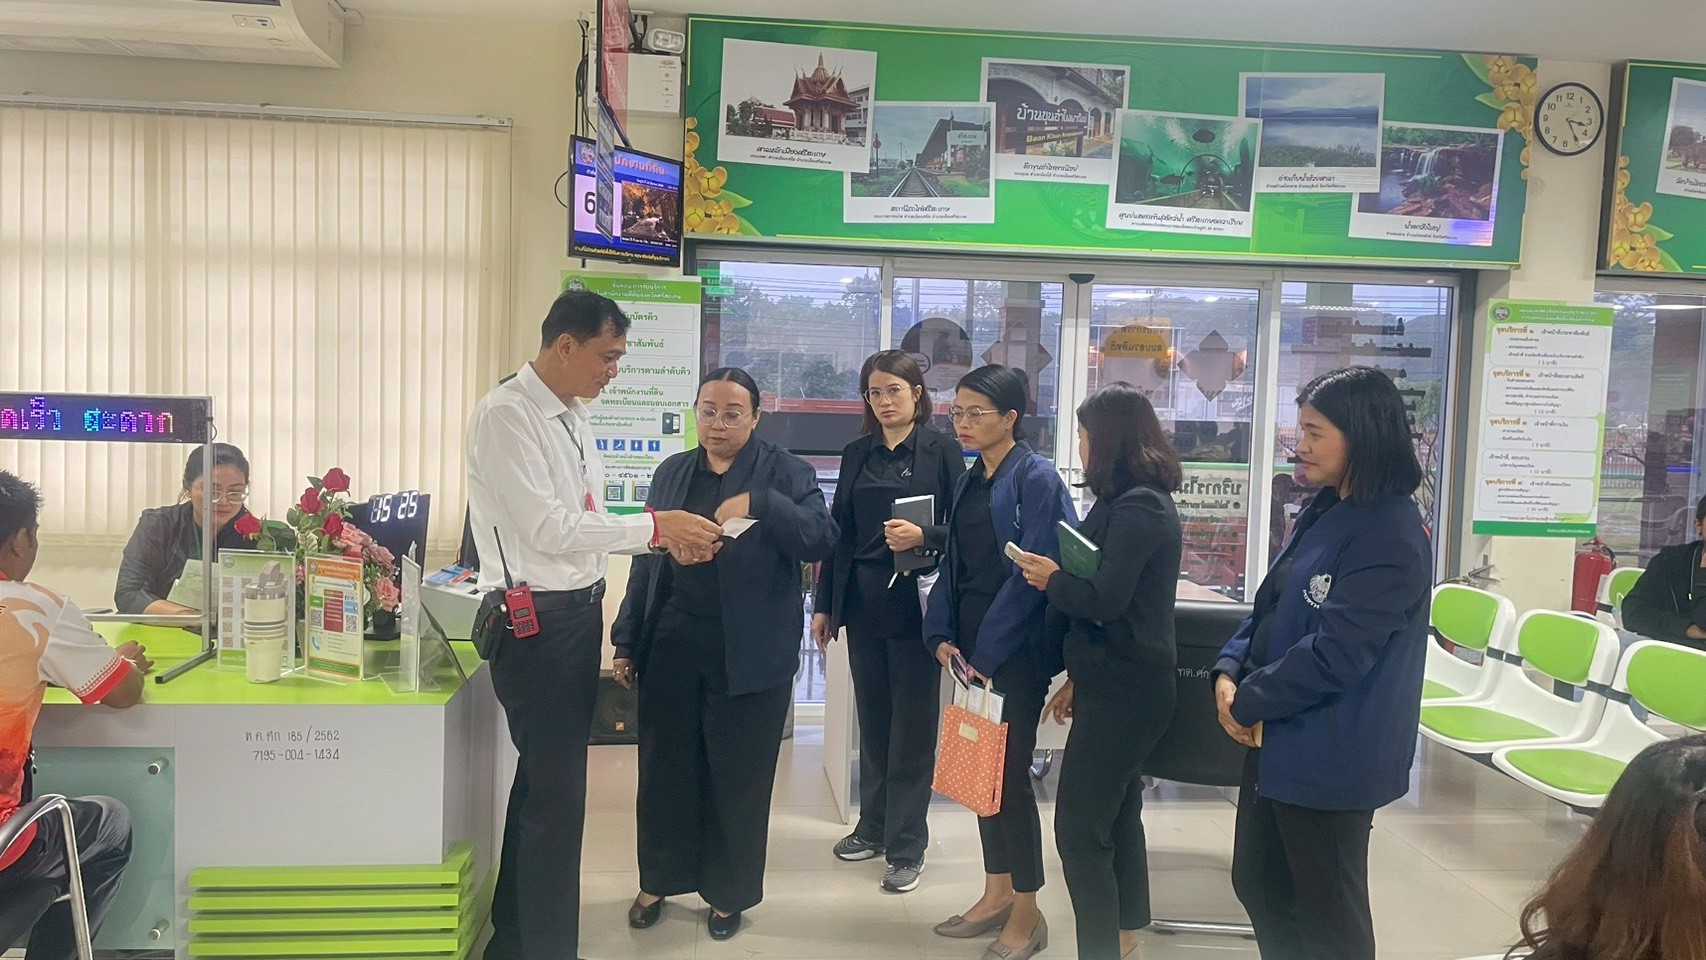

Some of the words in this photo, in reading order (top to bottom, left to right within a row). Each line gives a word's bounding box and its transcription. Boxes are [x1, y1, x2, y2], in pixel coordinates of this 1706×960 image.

[1566, 92, 1575, 100] 12
[1543, 114, 1548, 122] 9
[1026, 134, 1046, 143] Baan
[1552, 135, 1557, 143] 7
[1563, 139, 1568, 147] 6
[614, 154, 668, 176] นักงานที่ดิน
[609, 385, 664, 396] เจ้าพนักงานที่ดิน
[84, 407, 173, 433] สะดวก
[397, 491, 419, 519] 25
